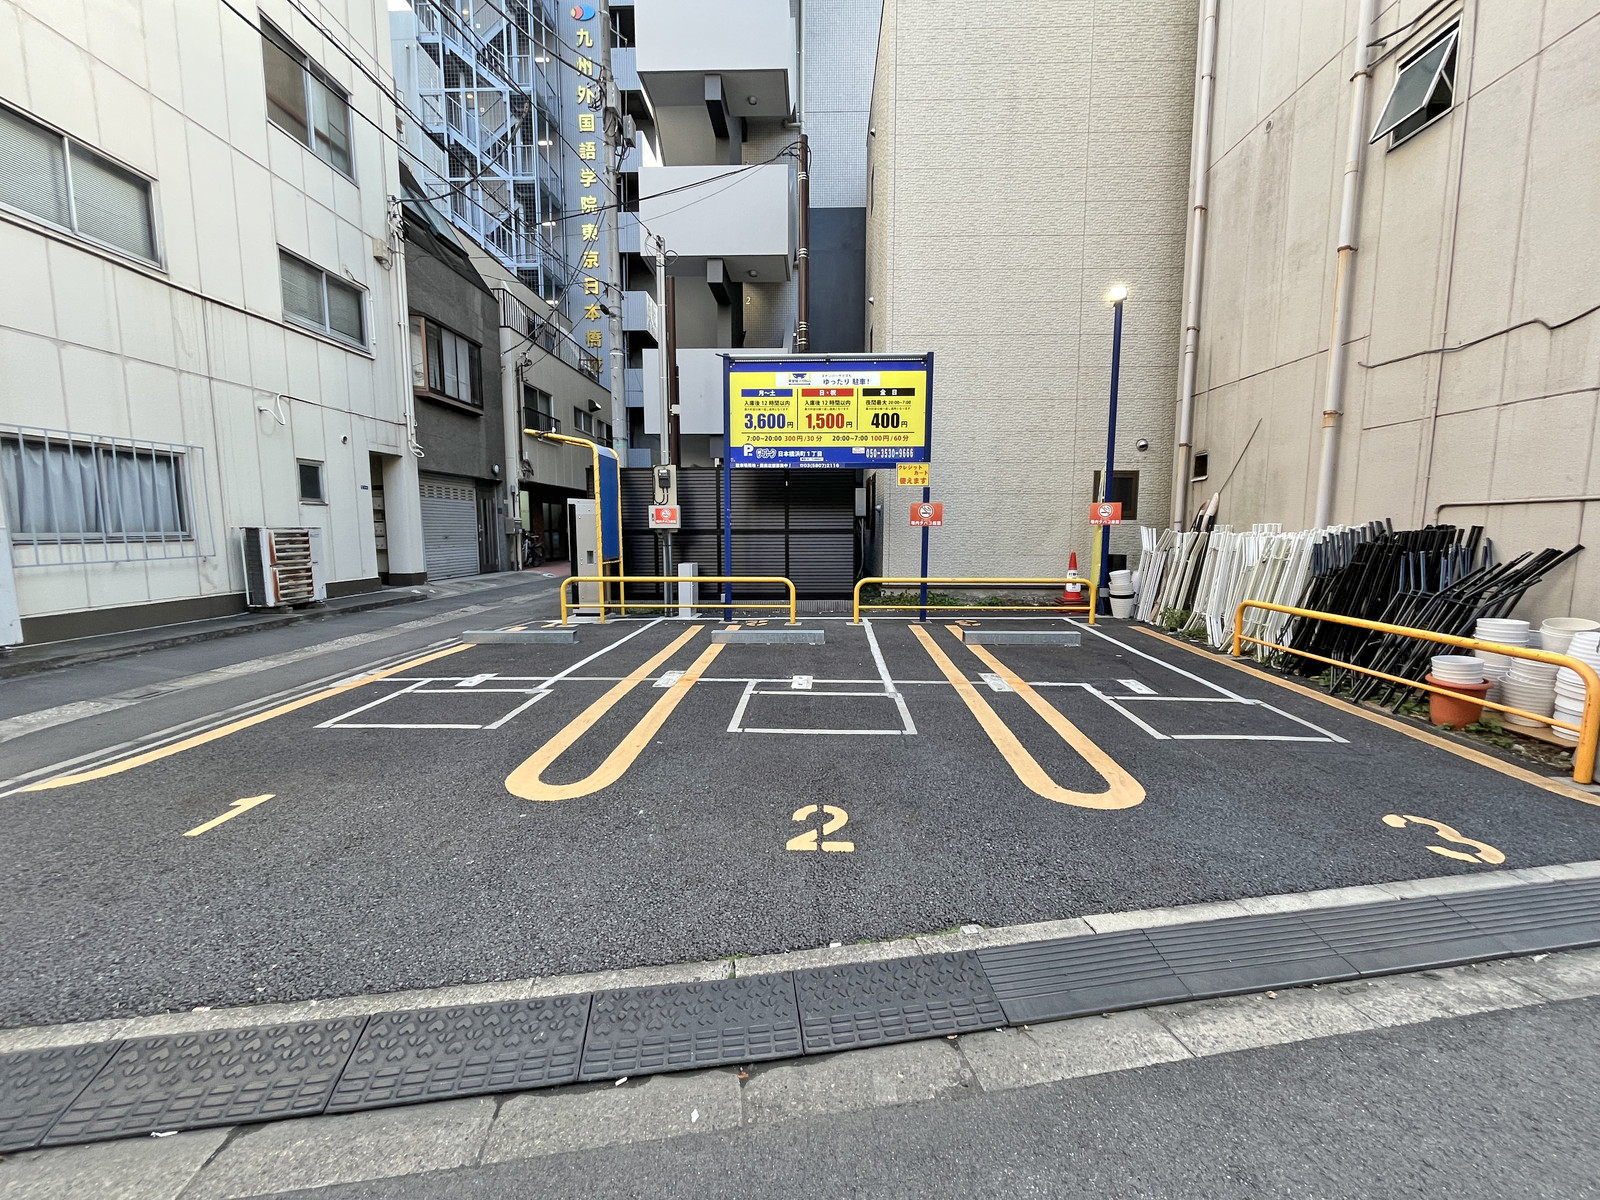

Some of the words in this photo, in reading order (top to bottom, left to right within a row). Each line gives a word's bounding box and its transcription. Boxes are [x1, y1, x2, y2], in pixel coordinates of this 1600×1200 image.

[745, 296, 751, 305] 2
[183, 794, 276, 837] 1
[785, 804, 855, 853] 2
[1382, 813, 1506, 865] 3
